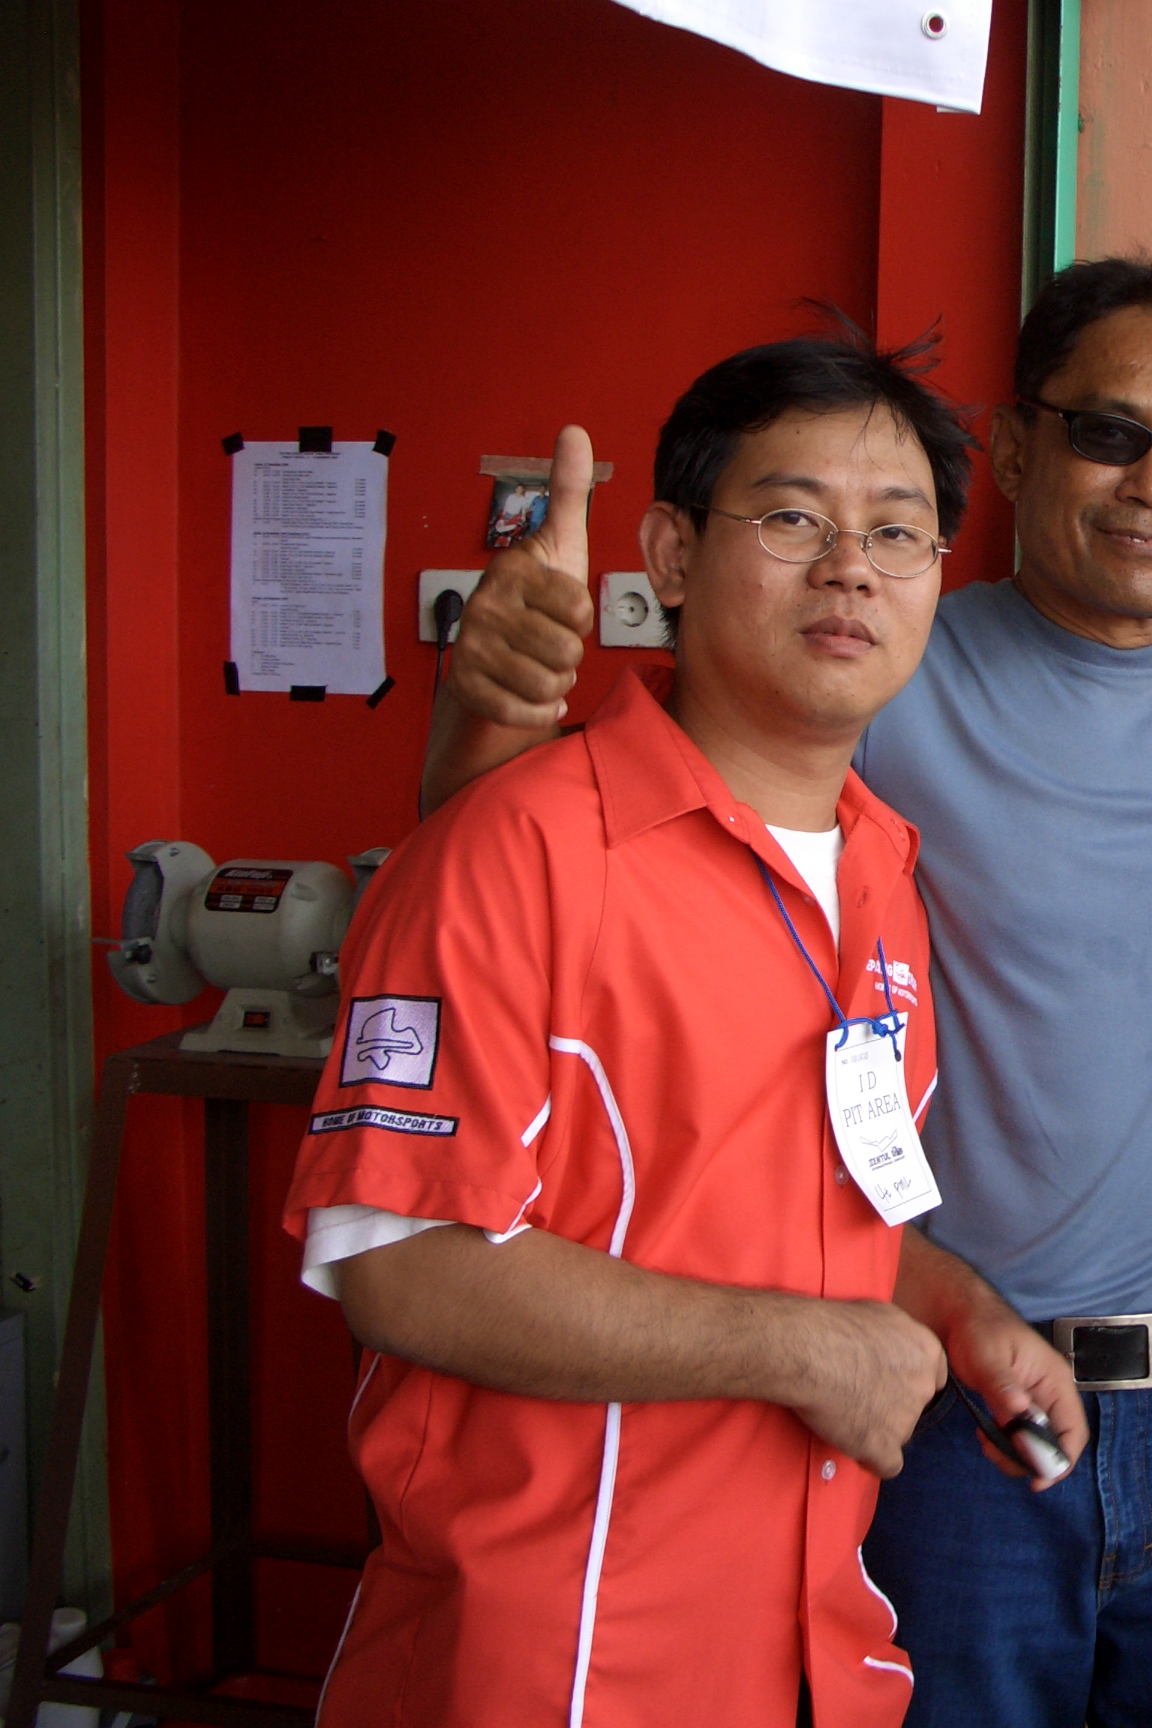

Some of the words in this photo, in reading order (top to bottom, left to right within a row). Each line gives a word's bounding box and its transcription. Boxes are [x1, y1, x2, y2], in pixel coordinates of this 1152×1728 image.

[347, 1114, 356, 1123] OF
[357, 1110, 443, 1130] MOTORSPORTS
[843, 1104, 863, 1128] PIT
[868, 1092, 901, 1120] AREA
